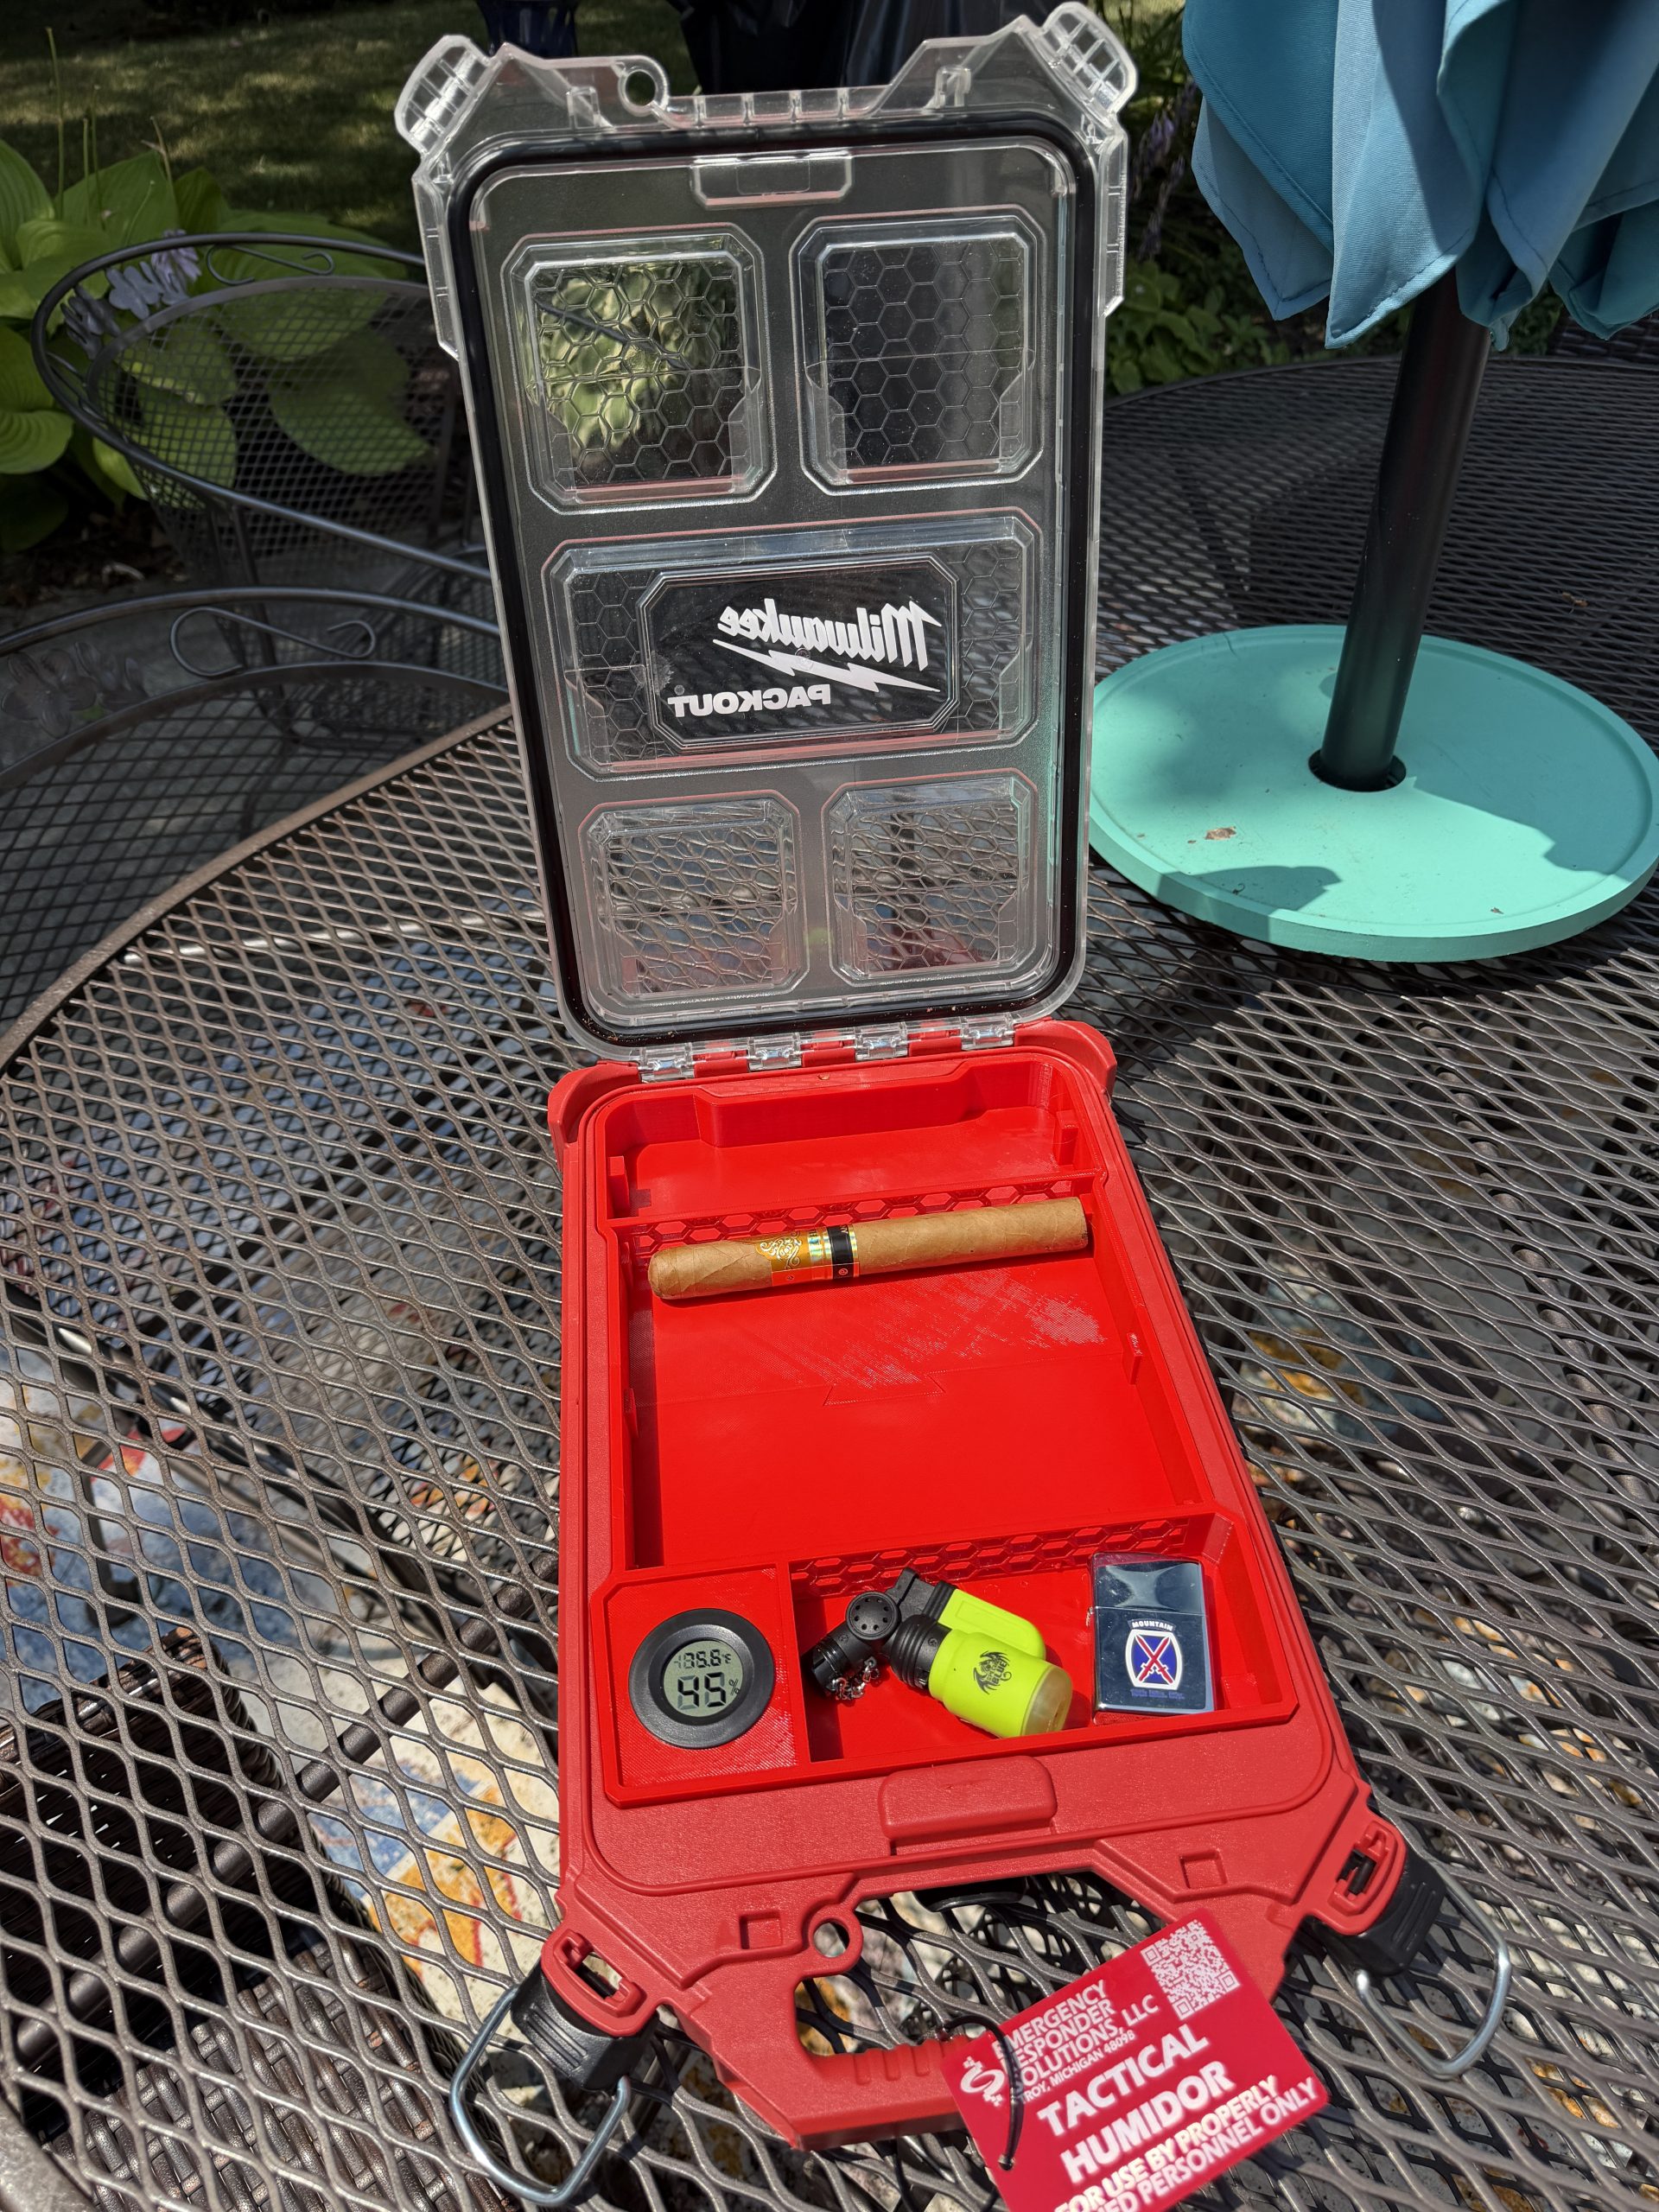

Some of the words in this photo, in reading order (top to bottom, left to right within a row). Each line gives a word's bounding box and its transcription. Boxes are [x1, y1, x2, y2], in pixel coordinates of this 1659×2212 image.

[1131, 1620, 1173, 1631] MOUNTAIN
[677, 1672, 726, 1708] 45
[1121, 1993, 1160, 2027] LLC
[1038, 2024, 1210, 2136] TACTICAL
[1049, 2048, 1105, 2088] MICHIGAN
[1060, 2060, 1236, 2183] HUMIDOR
[1102, 2157, 1150, 2197] USE
[1144, 2137, 1178, 2172] BY
[1173, 2074, 1279, 2154] PROPERLY
[1136, 2117, 1265, 2204] PERSONNEL
[1260, 2076, 1319, 2126] ONLY
